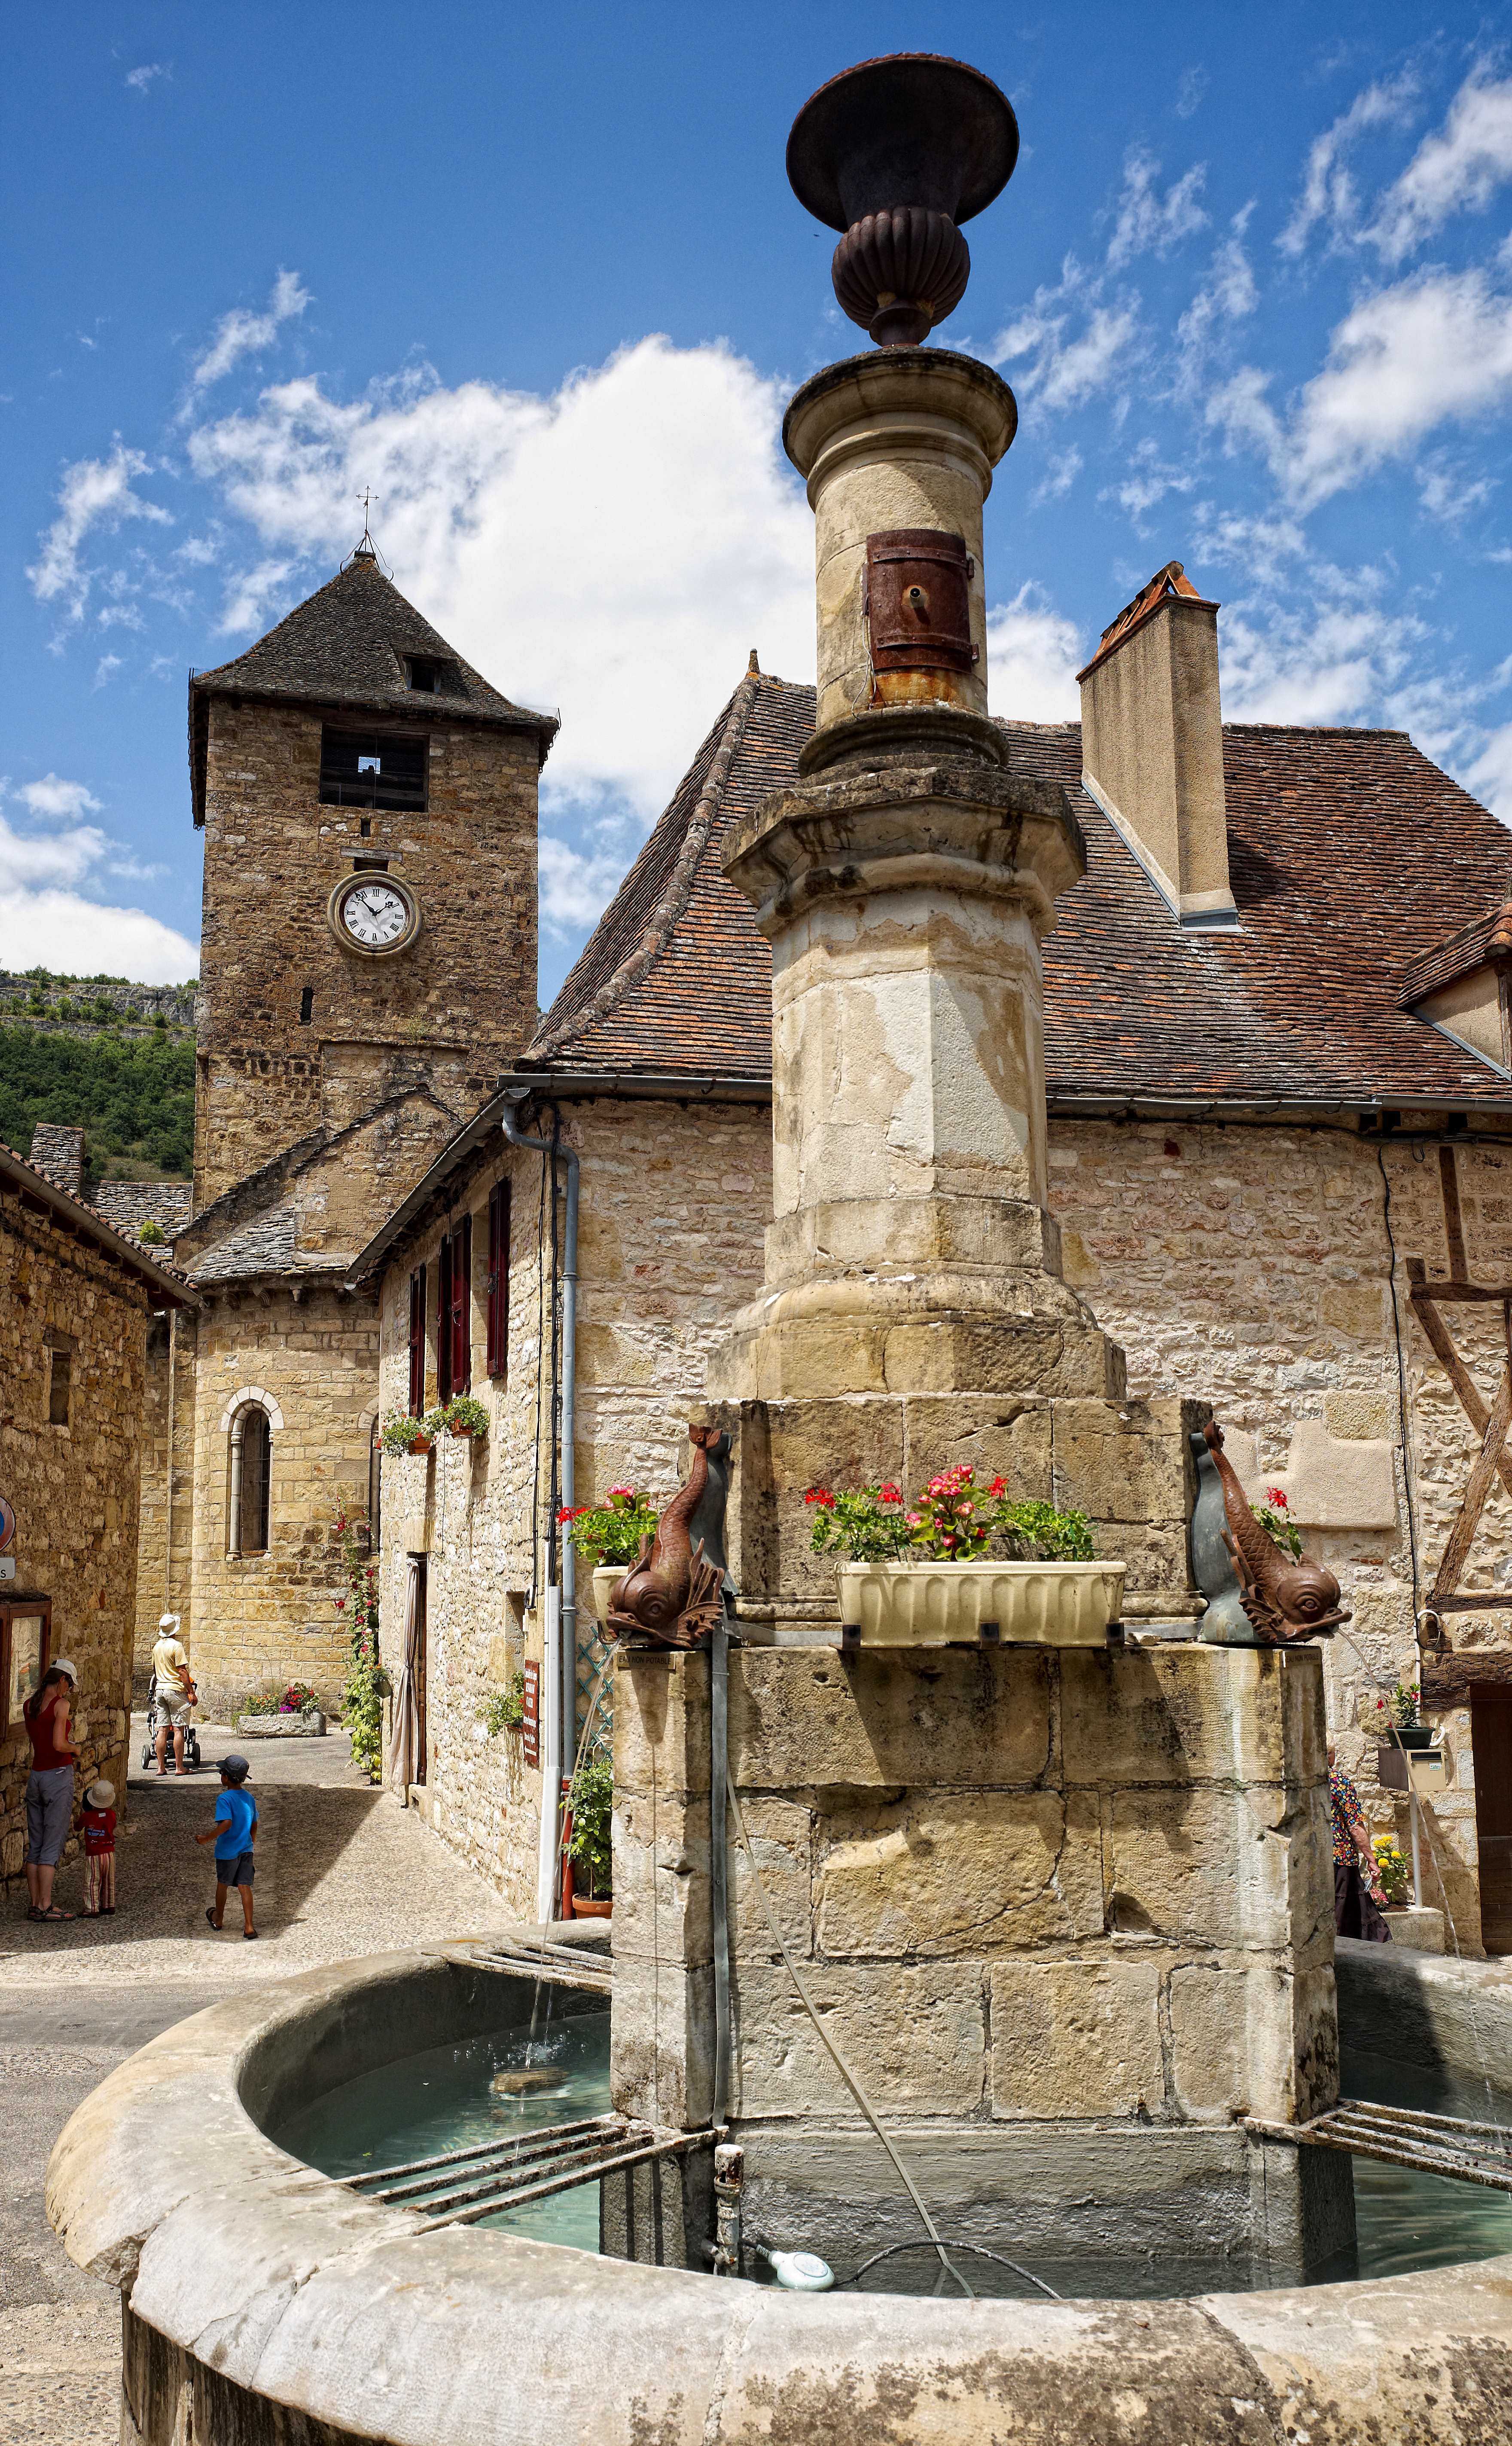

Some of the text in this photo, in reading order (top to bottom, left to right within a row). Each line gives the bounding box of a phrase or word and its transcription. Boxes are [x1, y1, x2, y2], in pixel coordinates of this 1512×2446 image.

[349, 919, 359, 929] VIII
[390, 923, 399, 932] IIII
[358, 928, 366, 938] VII
